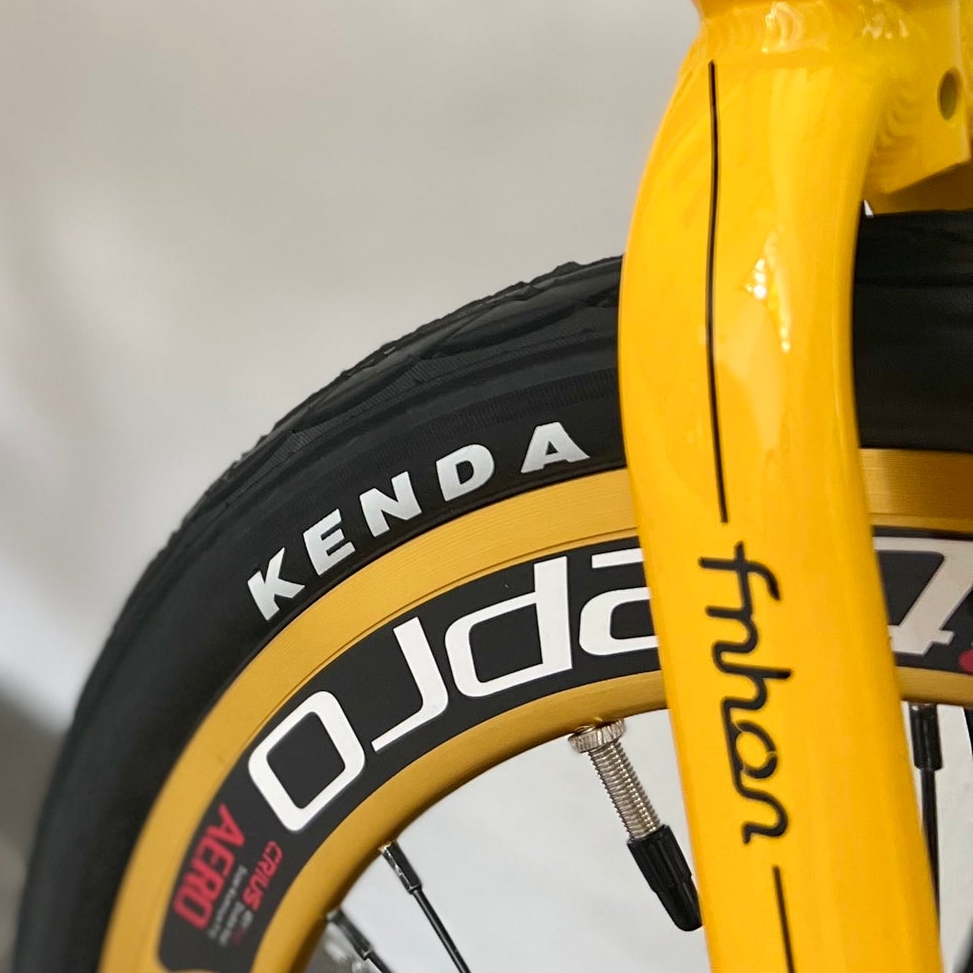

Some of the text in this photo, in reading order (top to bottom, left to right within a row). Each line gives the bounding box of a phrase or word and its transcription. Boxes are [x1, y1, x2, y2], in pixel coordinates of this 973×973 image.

[247, 422, 591, 622] KENDA
[172, 804, 246, 931] AERO
[242, 840, 284, 911] CRIUS
